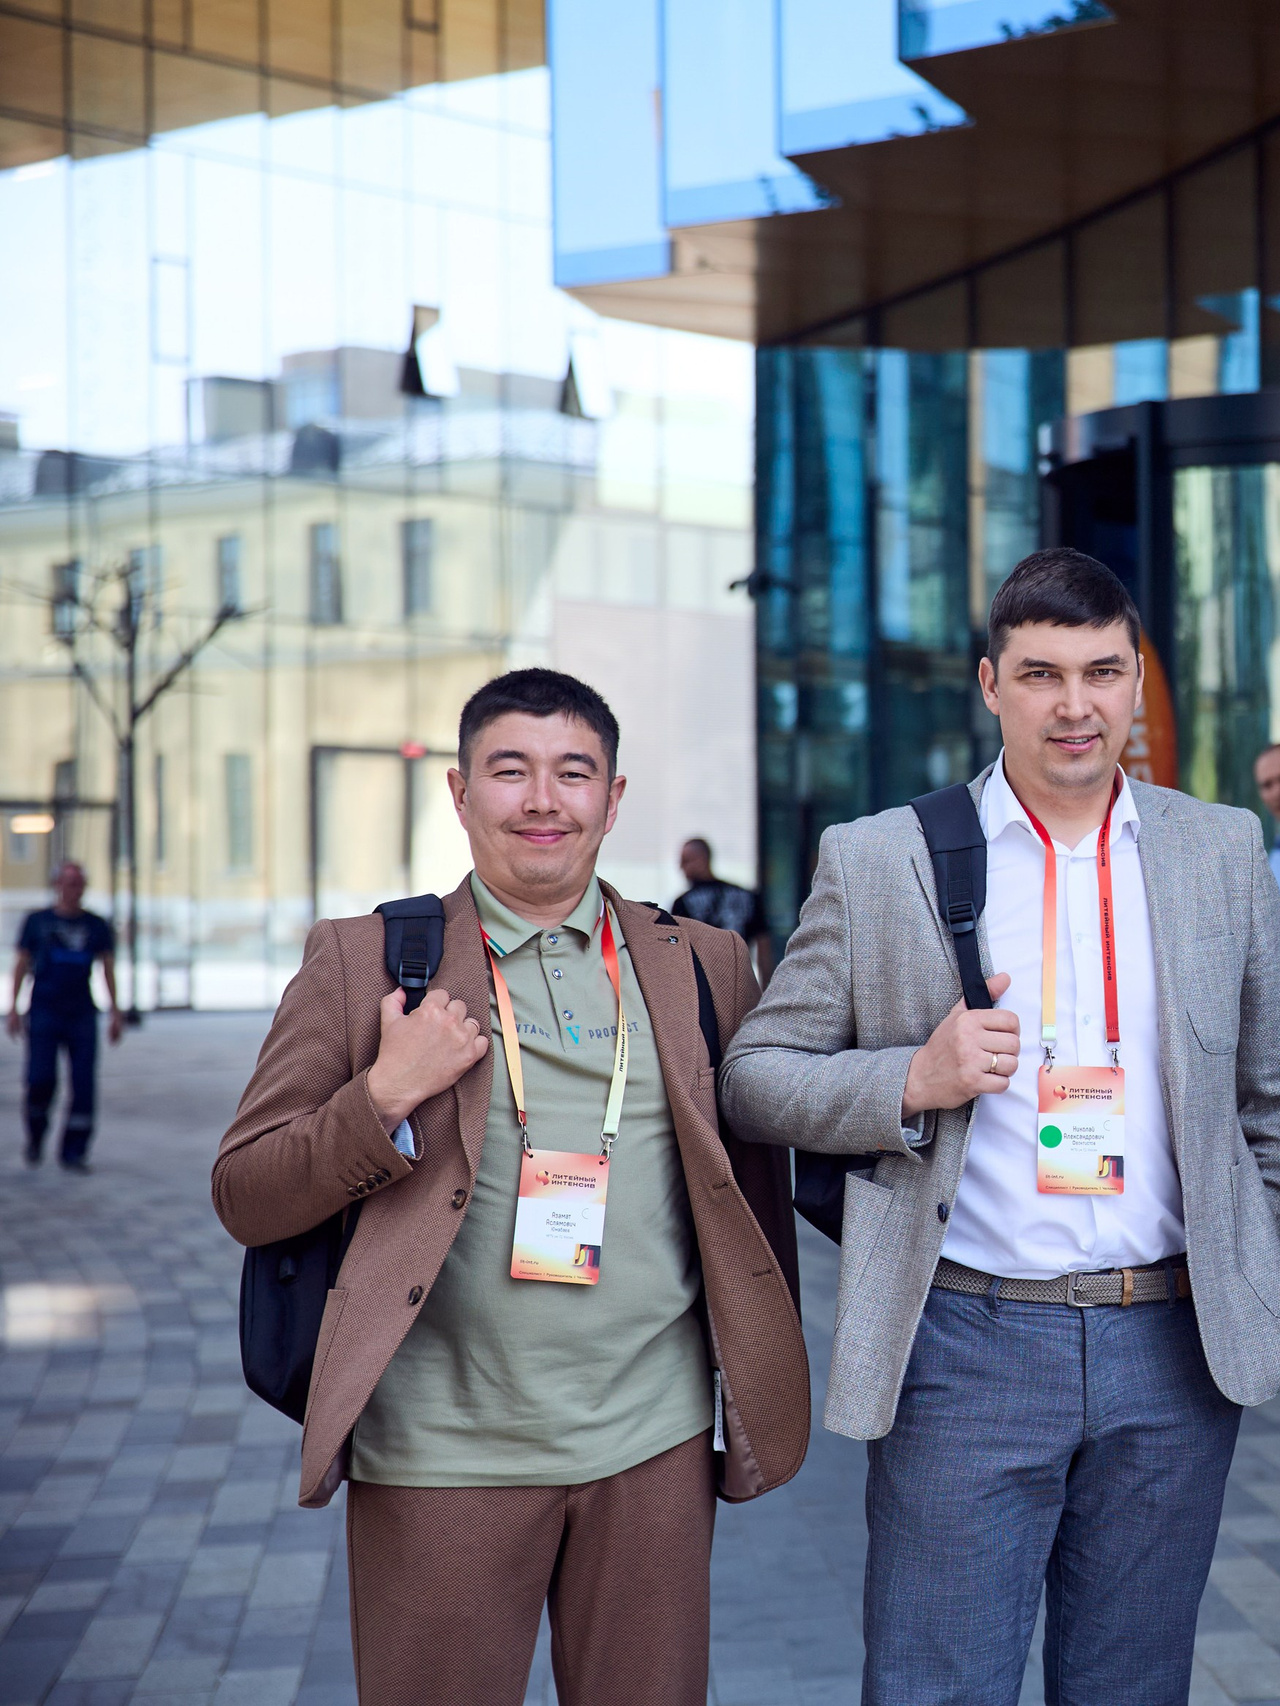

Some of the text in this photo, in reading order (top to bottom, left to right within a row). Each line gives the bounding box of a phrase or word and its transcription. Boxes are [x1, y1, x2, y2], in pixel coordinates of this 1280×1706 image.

[588, 1022, 638, 1039] PRODCT
[552, 1174, 596, 1183] ЛИТЕЙНЫЙ
[552, 1180, 595, 1188] ИНТЕНСИВ
